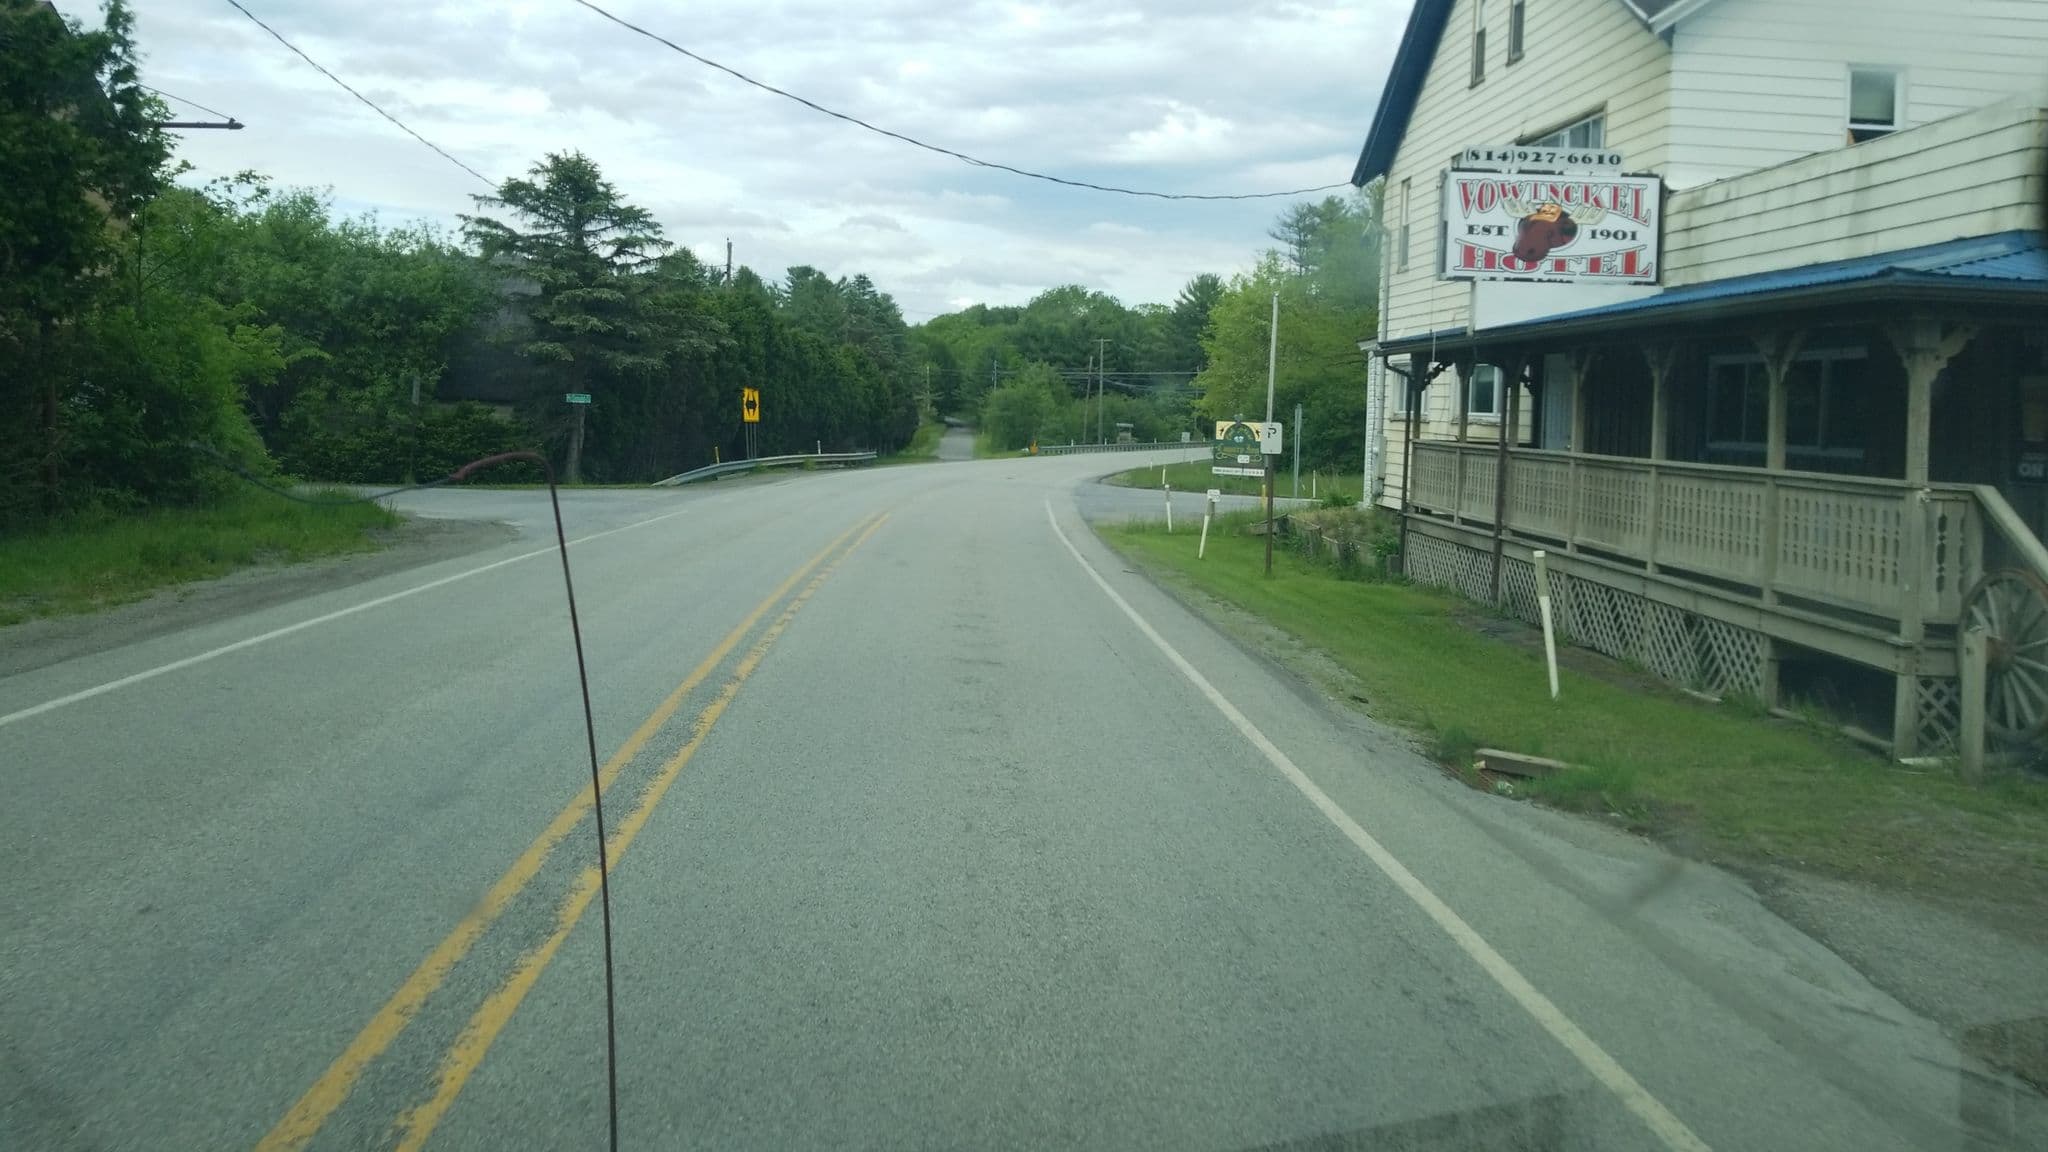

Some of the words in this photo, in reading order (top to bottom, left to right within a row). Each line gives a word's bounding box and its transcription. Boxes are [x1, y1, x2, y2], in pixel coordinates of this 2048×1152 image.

[1466, 149, 1622, 165] (814)927-6610
[1457, 178, 1651, 227] VOWINCKEL
[1466, 224, 1509, 237] EST
[1589, 229, 1638, 241] 1901
[1454, 238, 1653, 277] HOTEL
